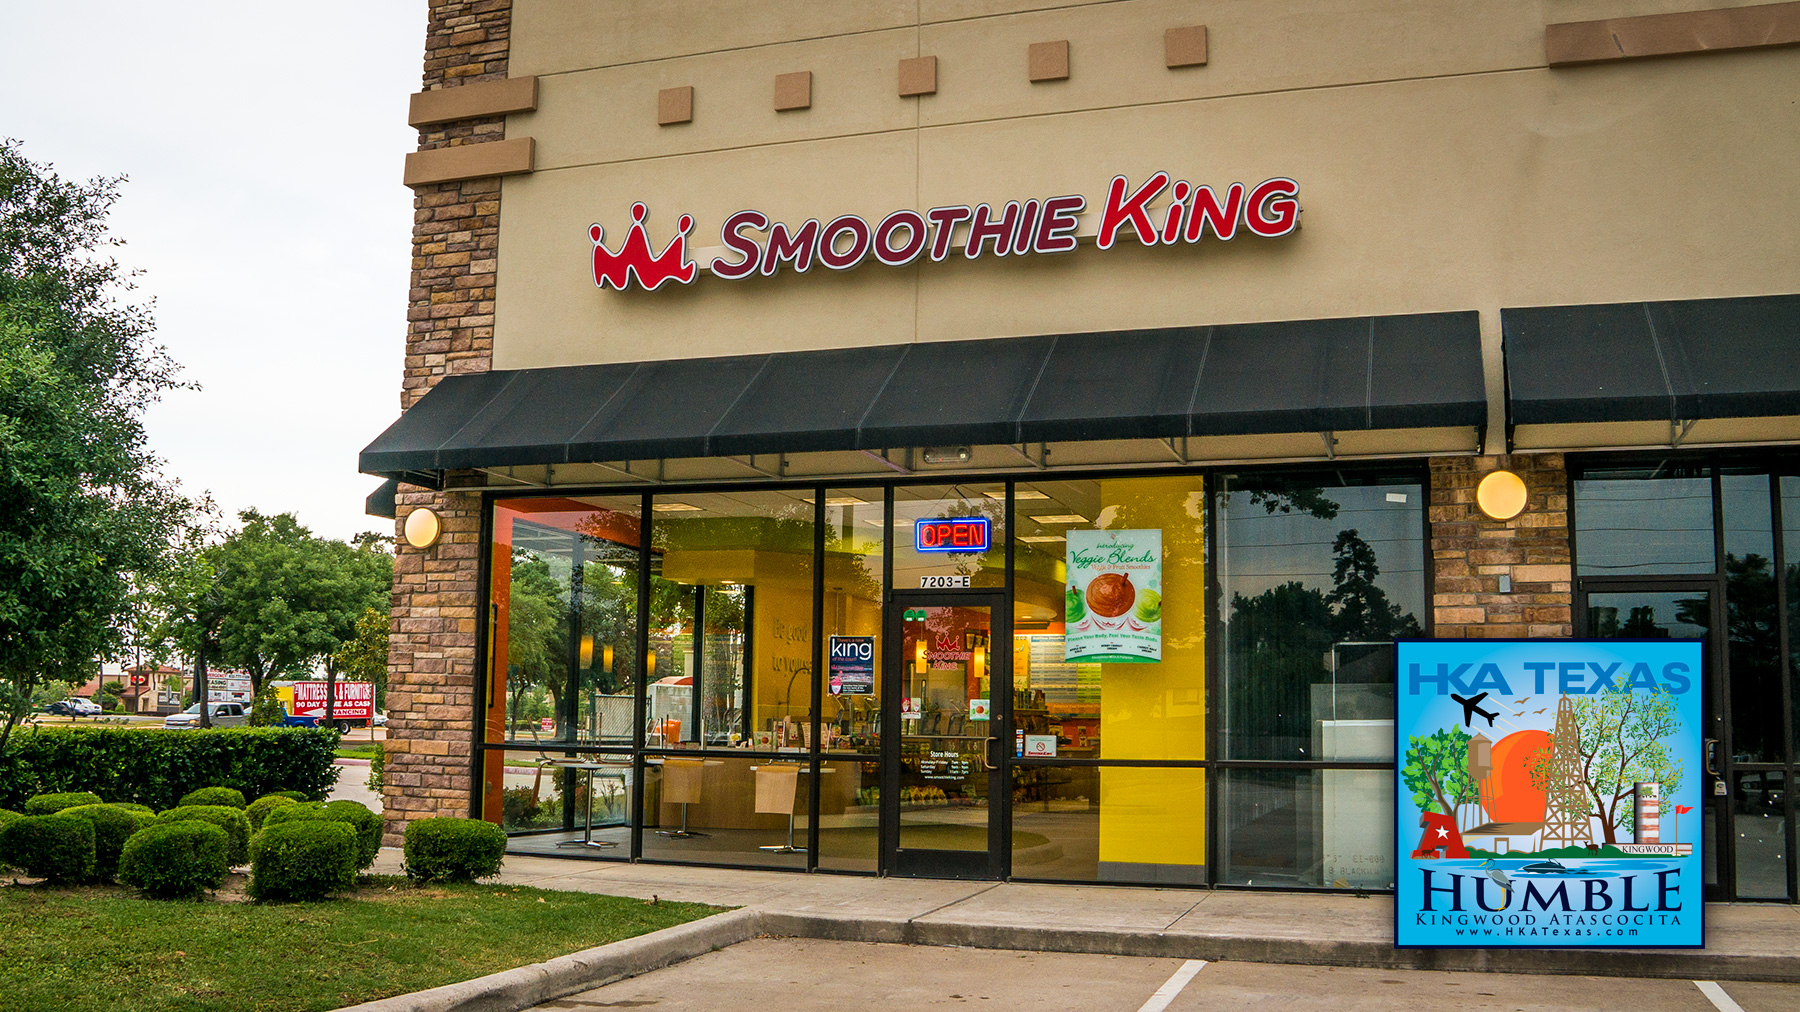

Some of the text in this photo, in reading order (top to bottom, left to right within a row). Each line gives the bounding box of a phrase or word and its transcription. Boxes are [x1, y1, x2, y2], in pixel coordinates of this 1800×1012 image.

[710, 194, 1086, 281] SMOOTHIE
[921, 523, 984, 547] OPEN
[1070, 548, 1158, 569] Veggie Blends
[921, 576, 970, 588] 7203-E
[831, 638, 872, 661] king
[921, 649, 972, 661] SMOOTHIE
[930, 750, 944, 758] Store
